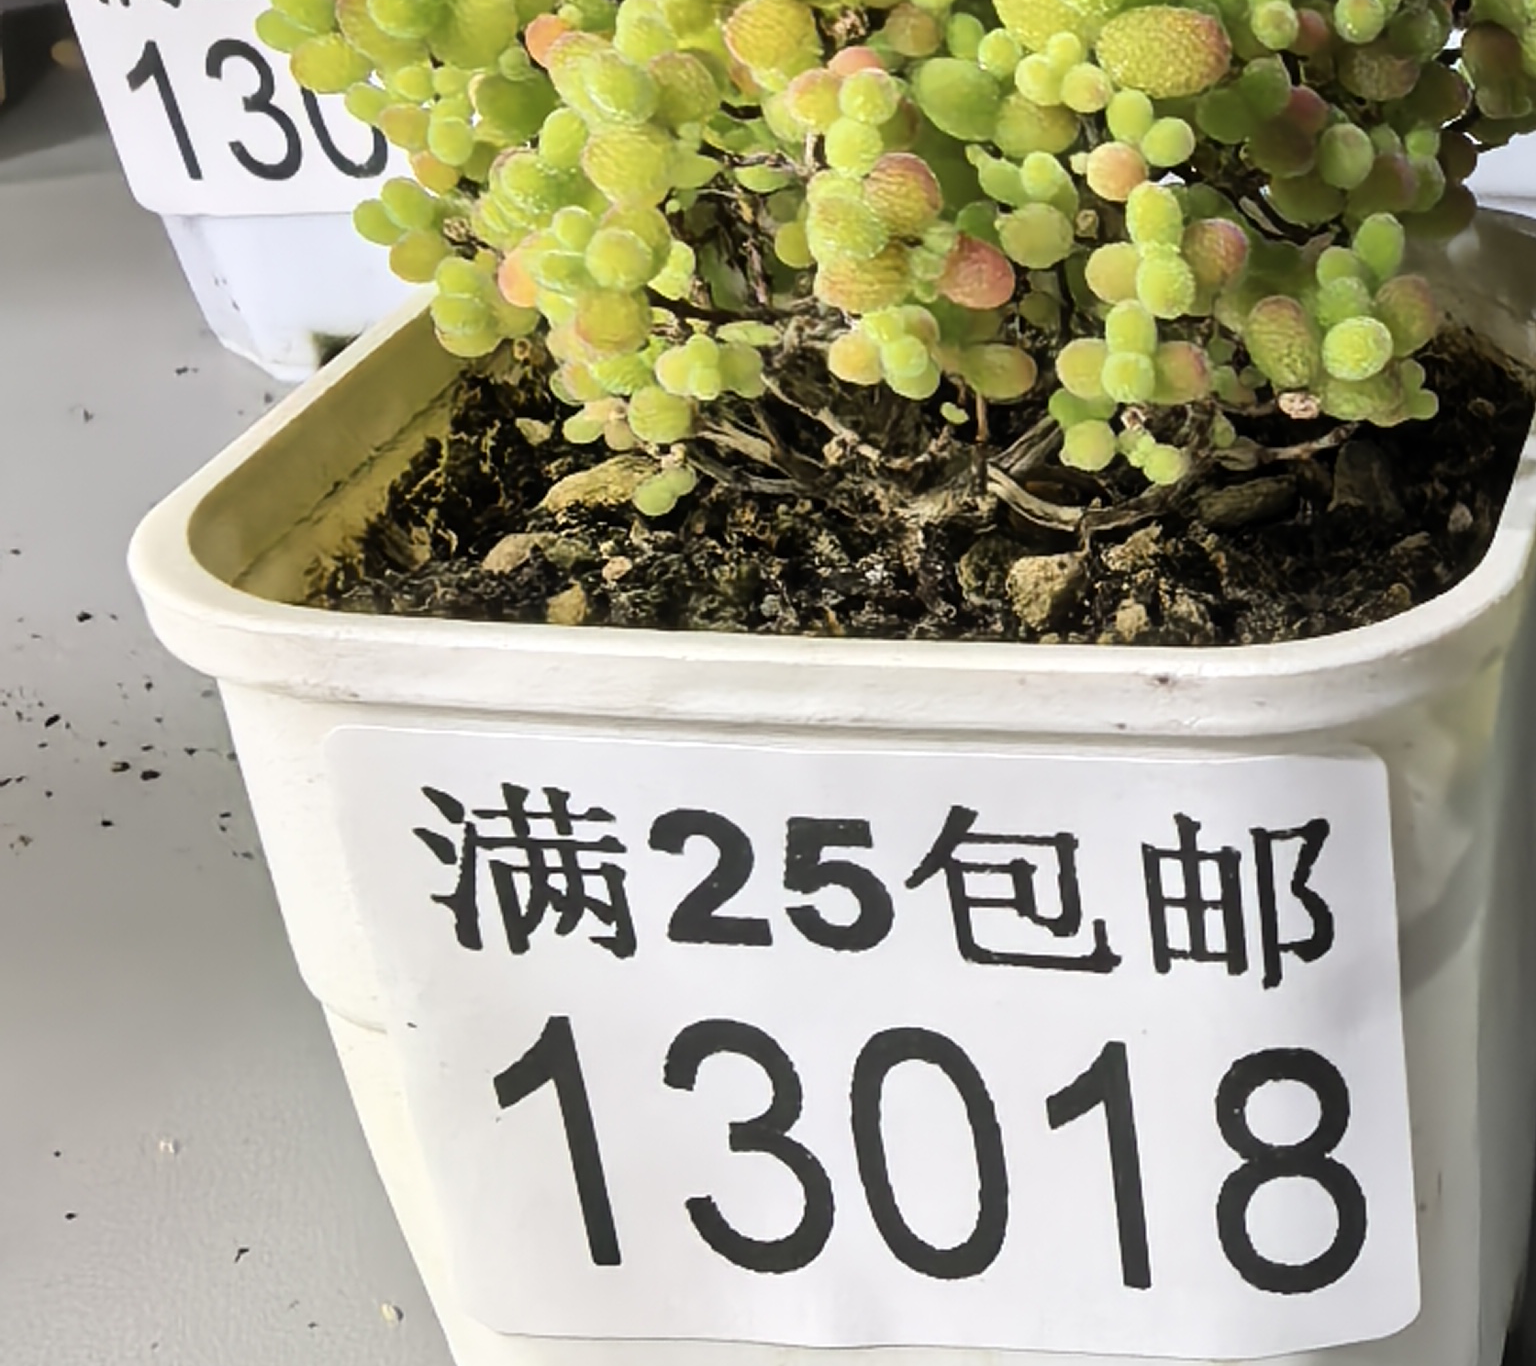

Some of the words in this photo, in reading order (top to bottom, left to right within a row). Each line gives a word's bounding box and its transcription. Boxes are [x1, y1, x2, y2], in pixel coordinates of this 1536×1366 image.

[413, 782, 1335, 990] 满25包邮
[493, 1016, 1367, 1296] 13018
